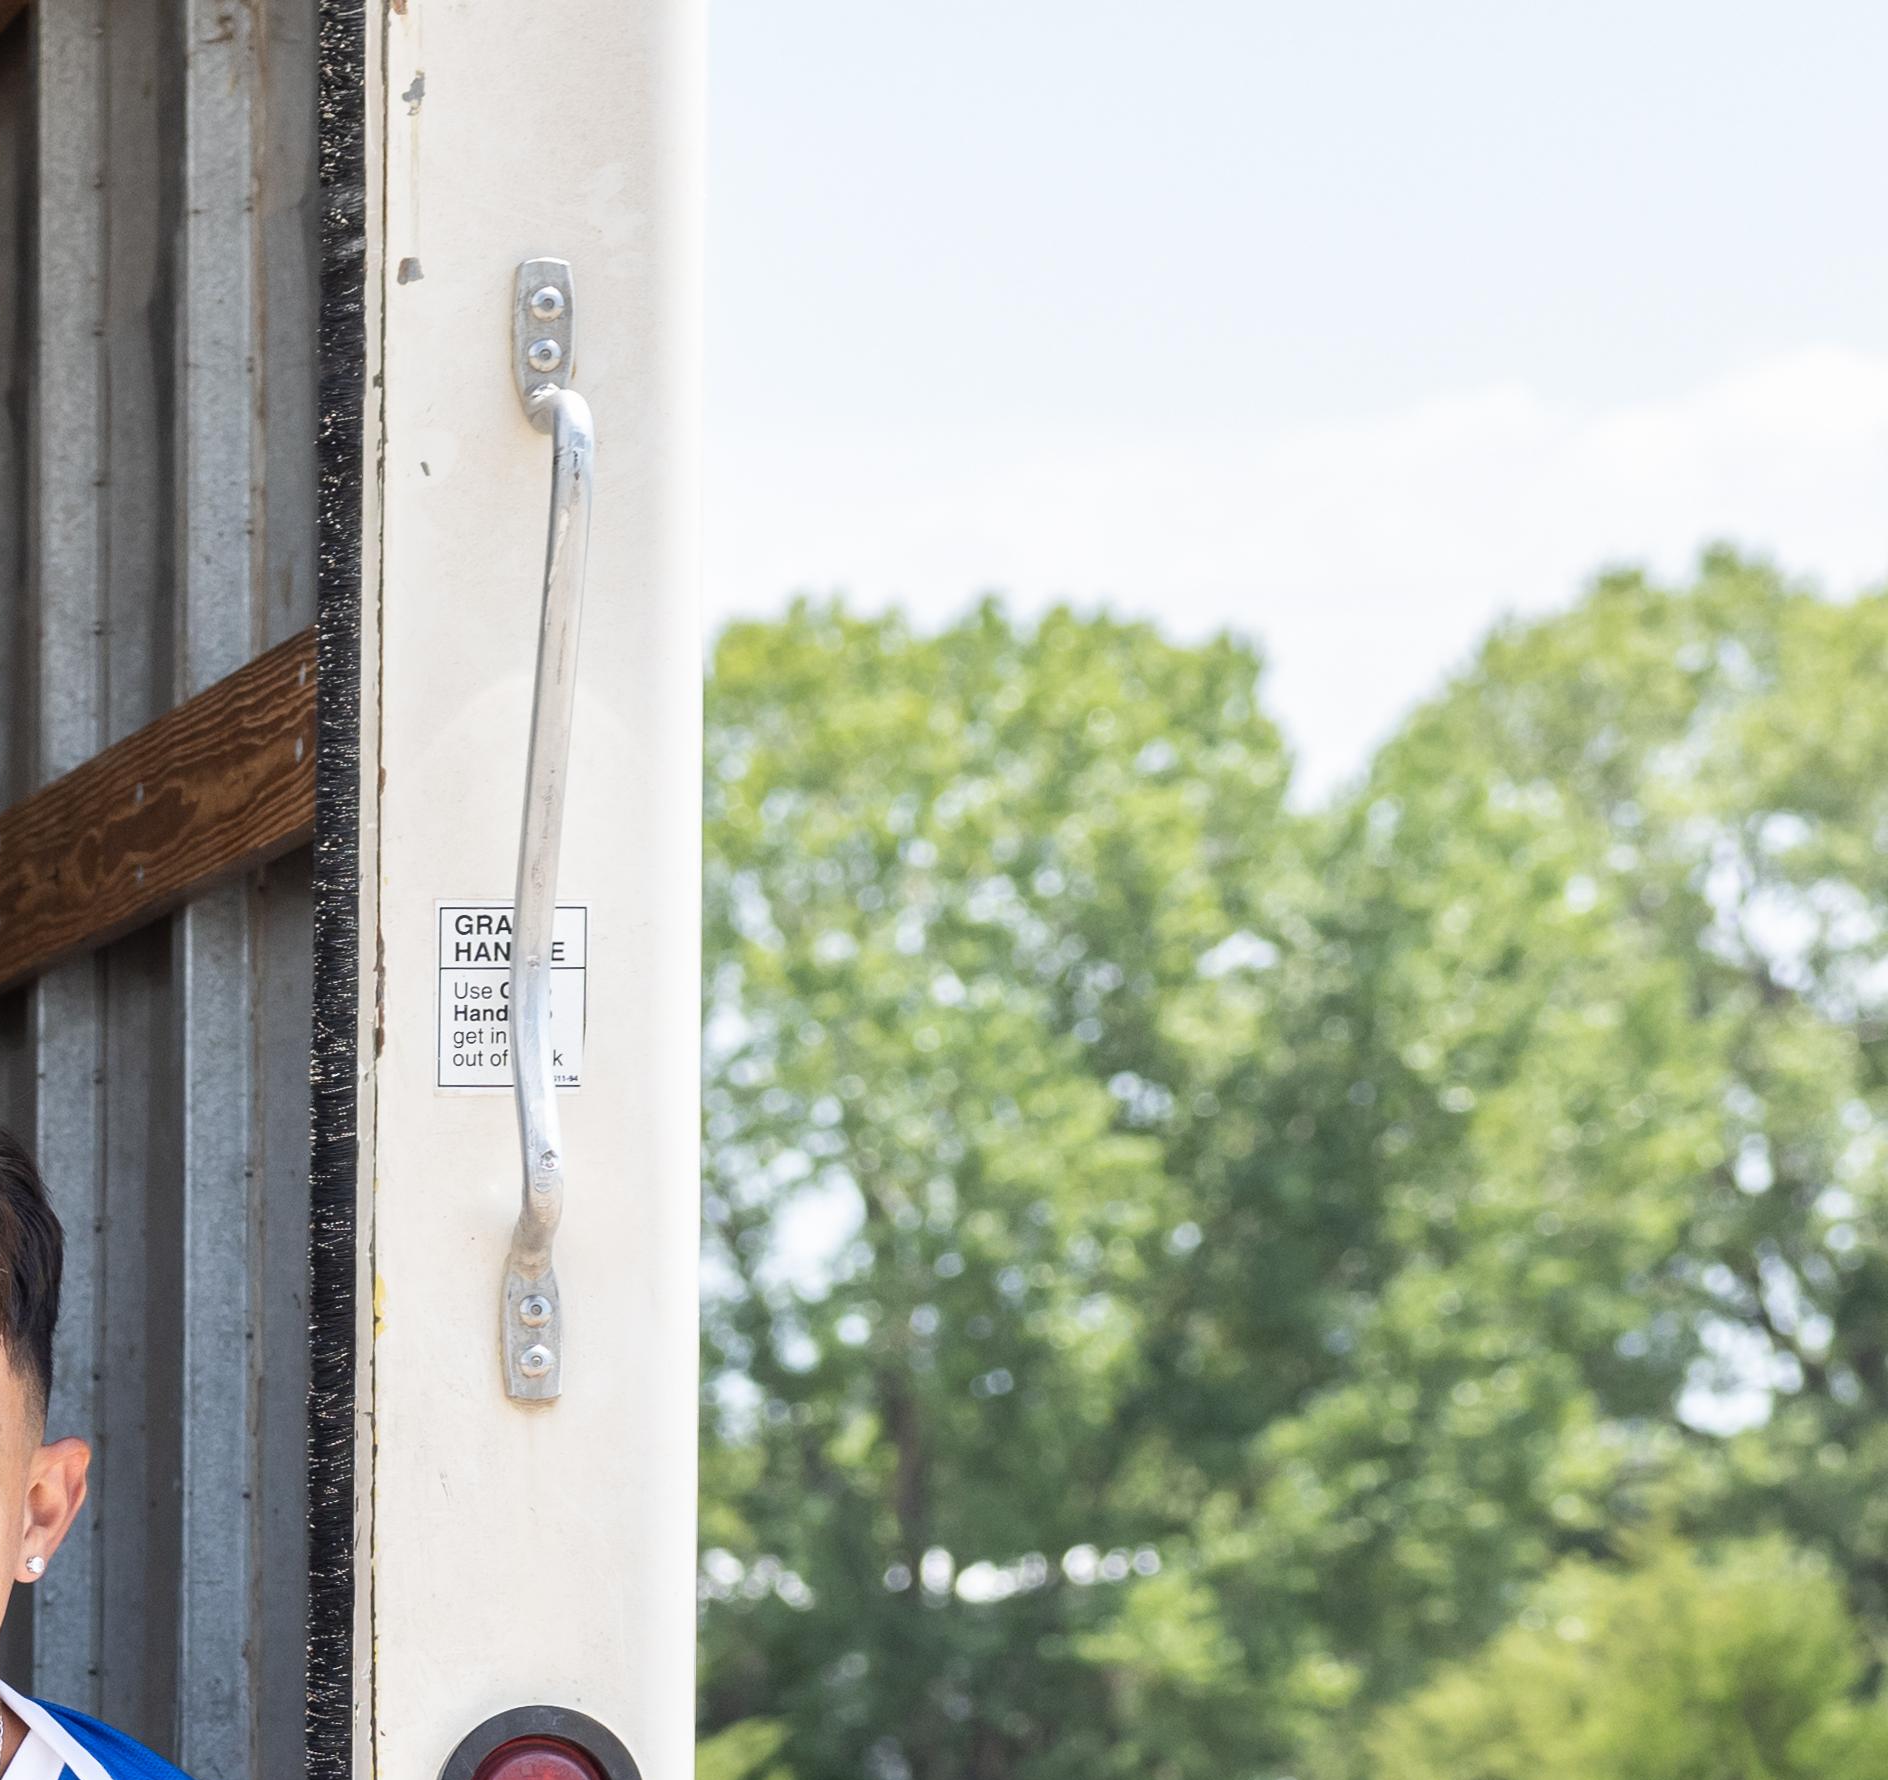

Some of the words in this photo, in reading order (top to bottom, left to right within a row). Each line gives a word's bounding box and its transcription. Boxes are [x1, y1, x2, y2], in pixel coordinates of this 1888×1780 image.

[455, 914, 513, 936] GRA
[455, 941, 565, 962] HANE
[454, 982, 493, 1000] Use
[454, 1004, 509, 1022] Hand
[453, 1028, 484, 1049] get
[491, 1026, 507, 1044] in
[452, 1051, 484, 1067] out
[490, 1048, 509, 1067] of
